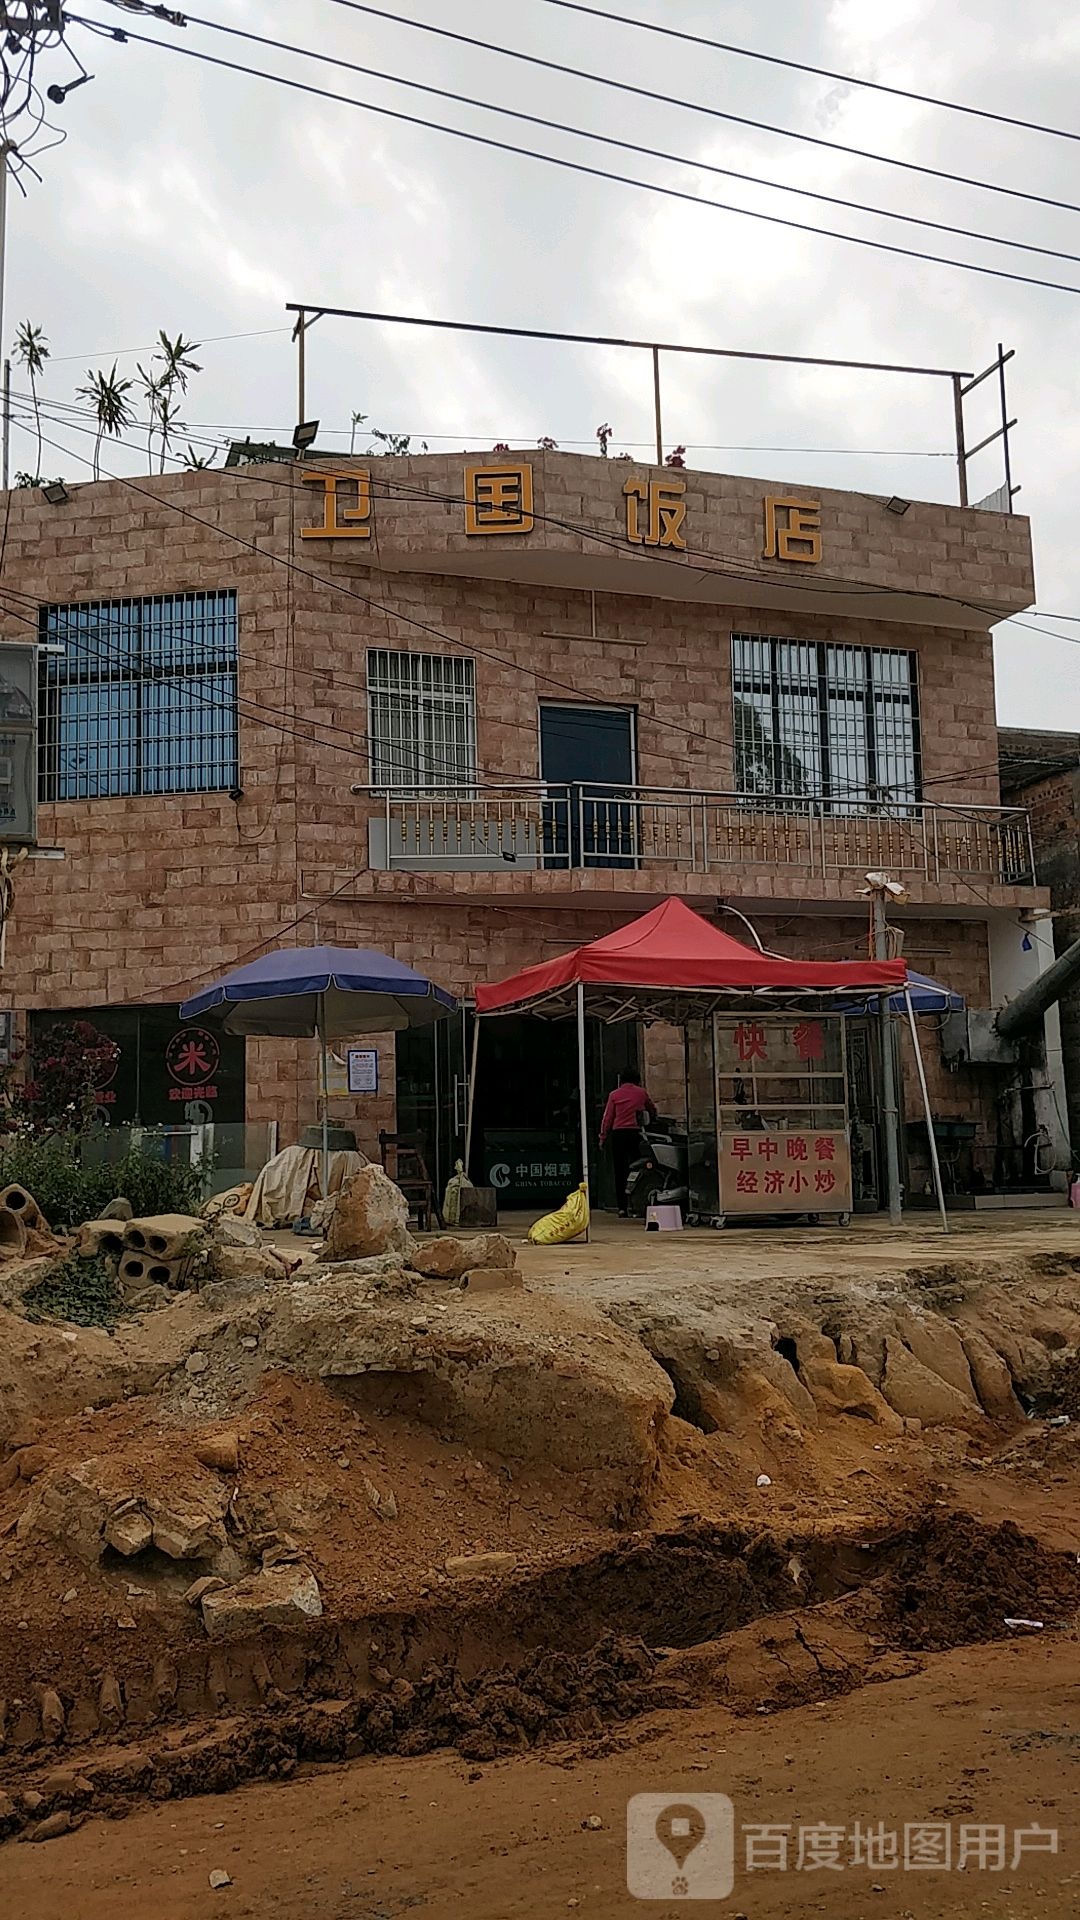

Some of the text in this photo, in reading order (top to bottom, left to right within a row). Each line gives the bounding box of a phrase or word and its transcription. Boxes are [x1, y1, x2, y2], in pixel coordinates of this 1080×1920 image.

[300, 464, 822, 564] 卫国饭店
[733, 1022, 824, 1060] 快餐
[731, 1137, 836, 1161] 早中晚餐
[515, 1163, 572, 1177] 中国烟草
[736, 1169, 836, 1194] 经济小炒
